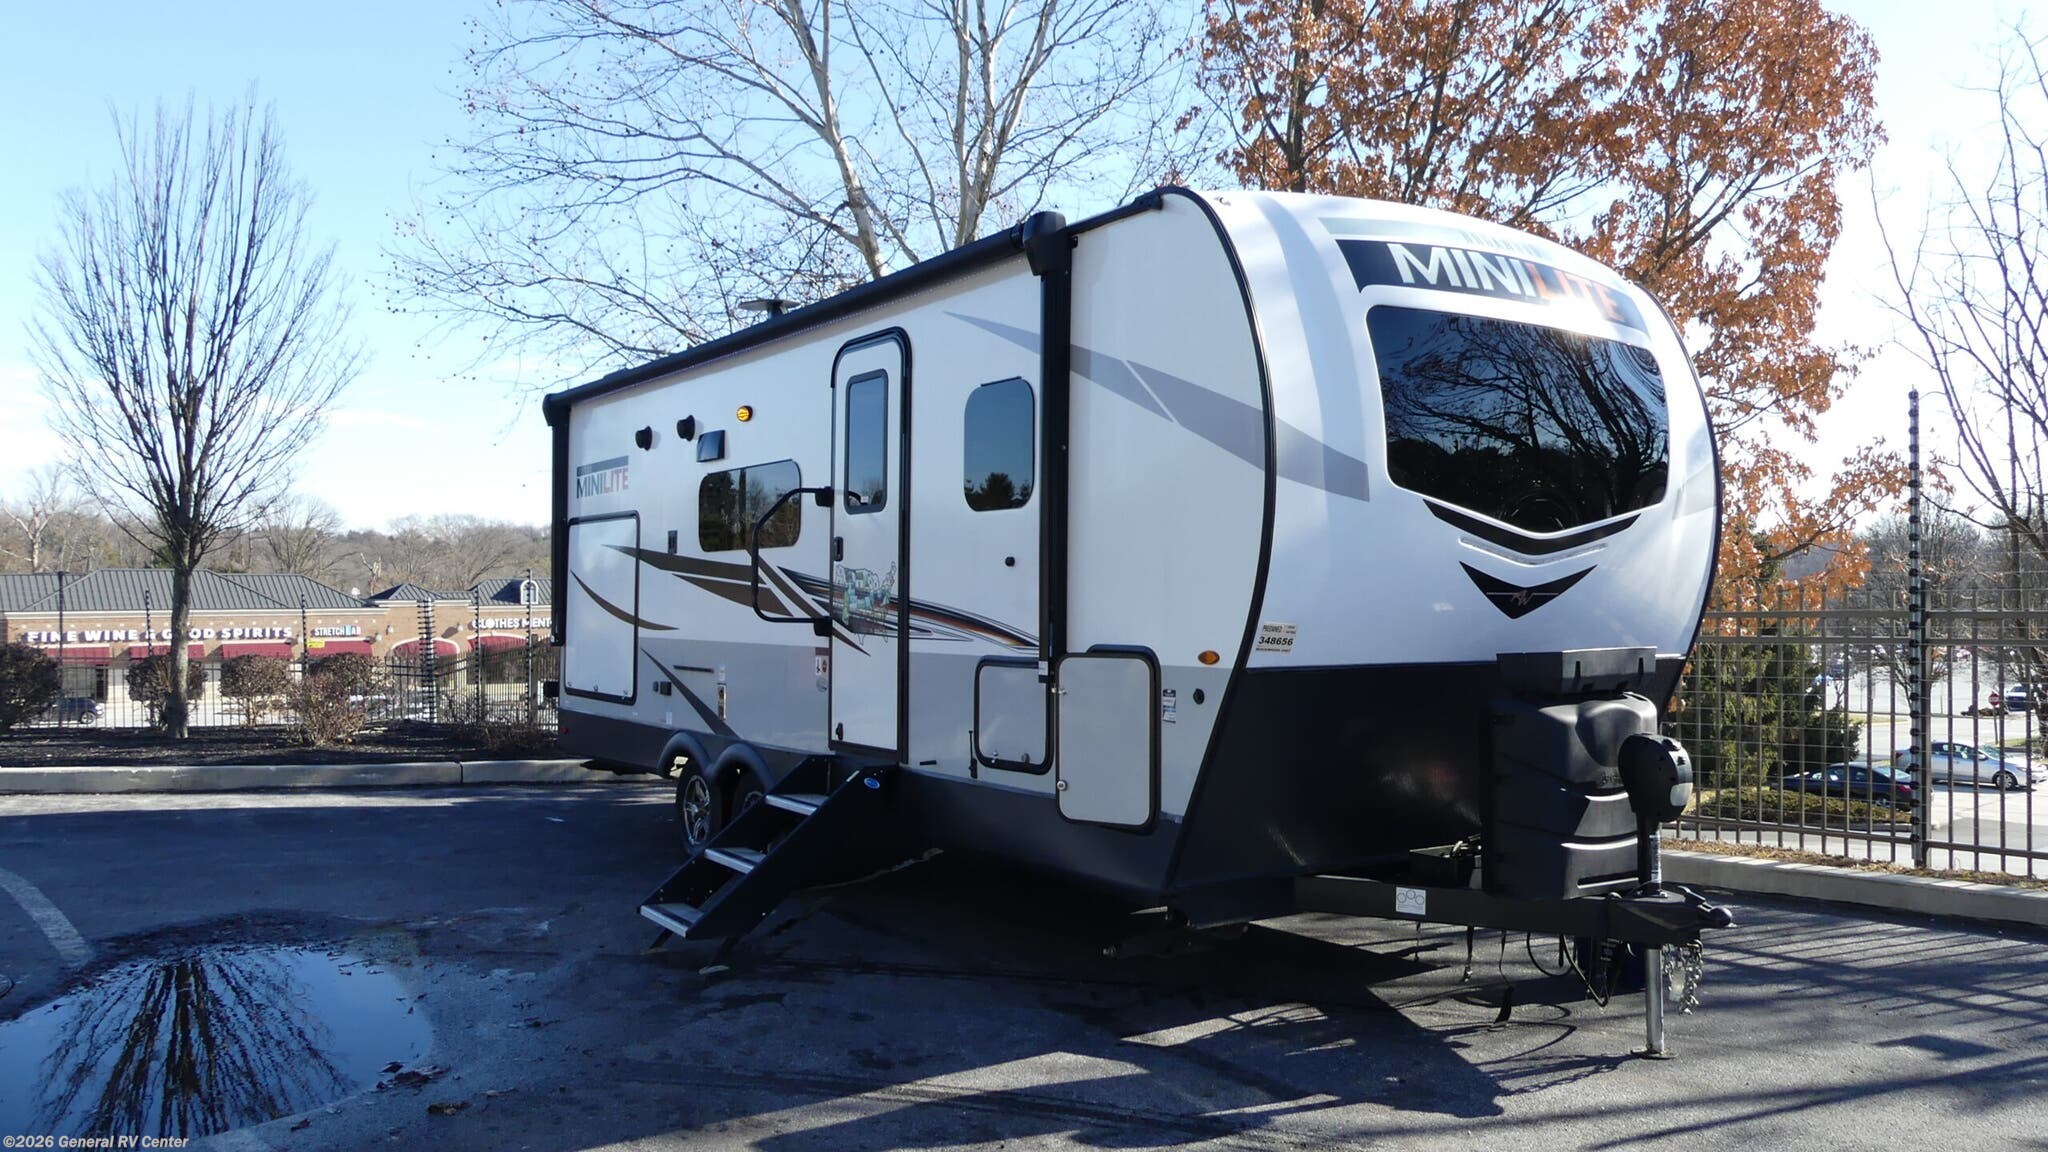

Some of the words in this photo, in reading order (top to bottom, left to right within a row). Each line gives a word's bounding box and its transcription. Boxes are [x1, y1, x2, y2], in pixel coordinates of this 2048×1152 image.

[1386, 242, 1626, 322] MINILITE
[576, 466, 629, 499] MINILITE
[472, 617, 520, 629] CLOTHES
[521, 617, 553, 628] MENT
[26, 631, 79, 642] FINE
[84, 629, 139, 642] WINE
[161, 628, 216, 640] GOD
[221, 626, 293, 640] SPIRITS
[1258, 635, 1294, 647] 348656
